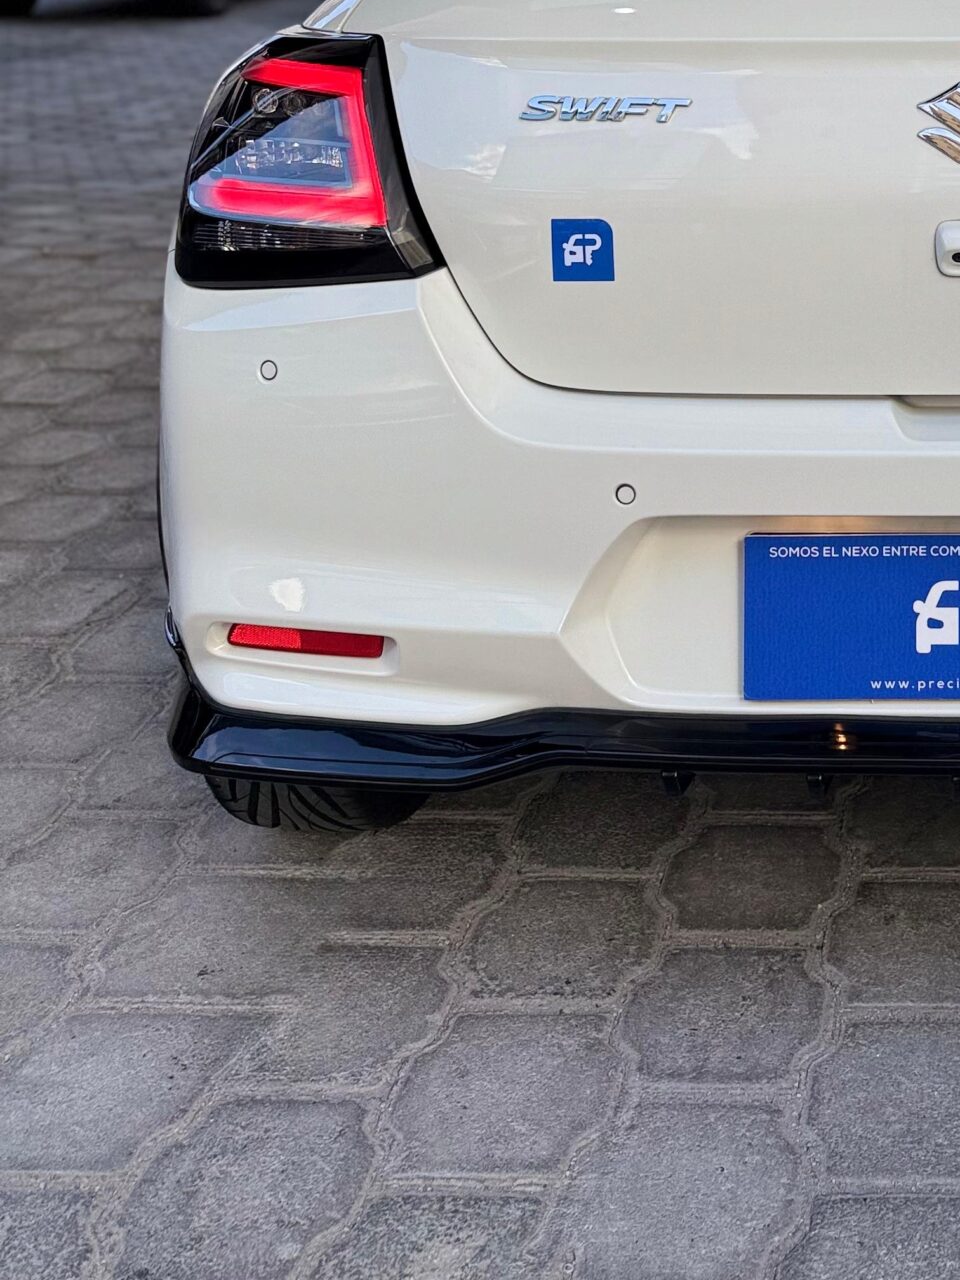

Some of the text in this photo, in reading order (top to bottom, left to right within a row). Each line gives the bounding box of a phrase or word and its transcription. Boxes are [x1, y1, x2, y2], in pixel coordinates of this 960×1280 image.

[519, 94, 693, 124] SWIFT
[769, 546, 819, 558] SOMOS
[823, 546, 839, 558] EL
[842, 545, 880, 558] NEXO
[882, 545, 927, 557] ENTRE
